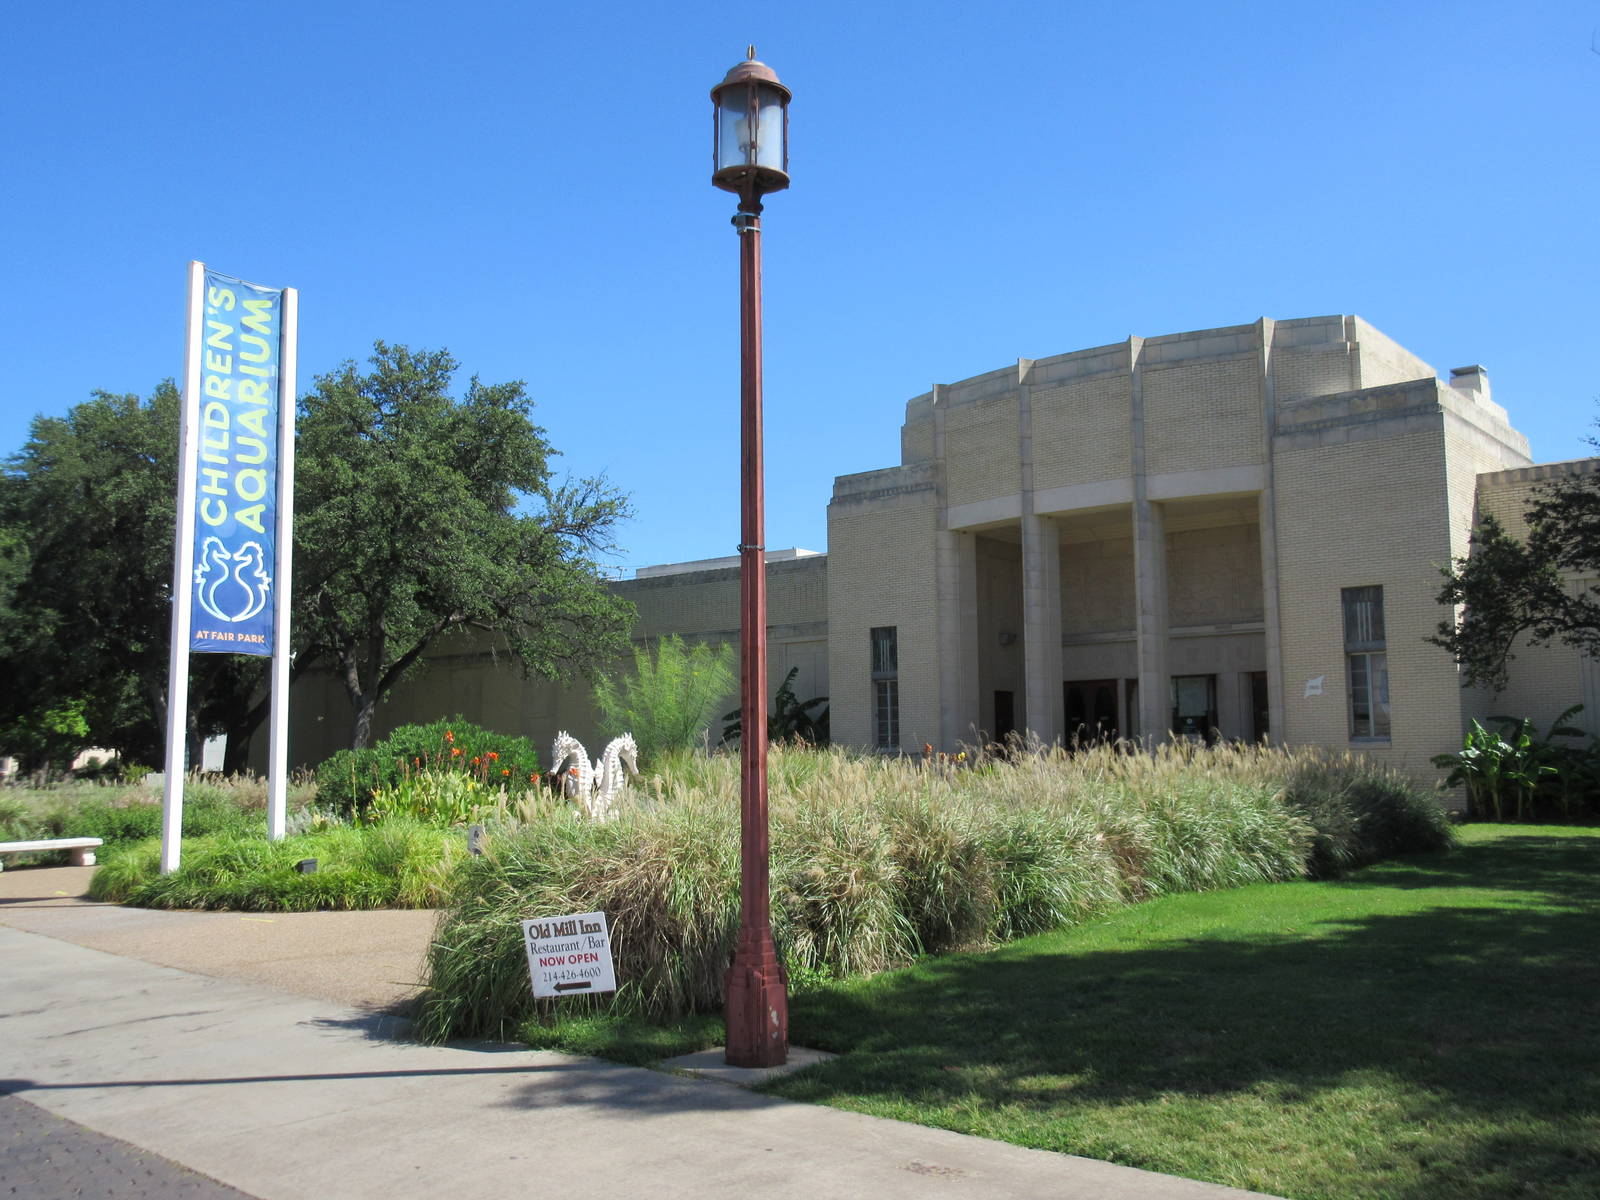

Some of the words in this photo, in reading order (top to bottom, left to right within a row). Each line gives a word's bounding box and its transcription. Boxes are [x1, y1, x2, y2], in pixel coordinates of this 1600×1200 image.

[201, 286, 236, 526] CHILDREN'S
[235, 299, 273, 534] AQUARIUM
[196, 630, 210, 639] AT
[211, 631, 235, 641] FAIR
[237, 633, 265, 643] PARK
[528, 922, 551, 940] Old
[552, 919, 578, 937] Mill
[579, 919, 602, 935] Inn
[539, 955, 565, 967] NOW
[568, 952, 599, 965] OPEN
[543, 967, 602, 982] 214-426-4600
